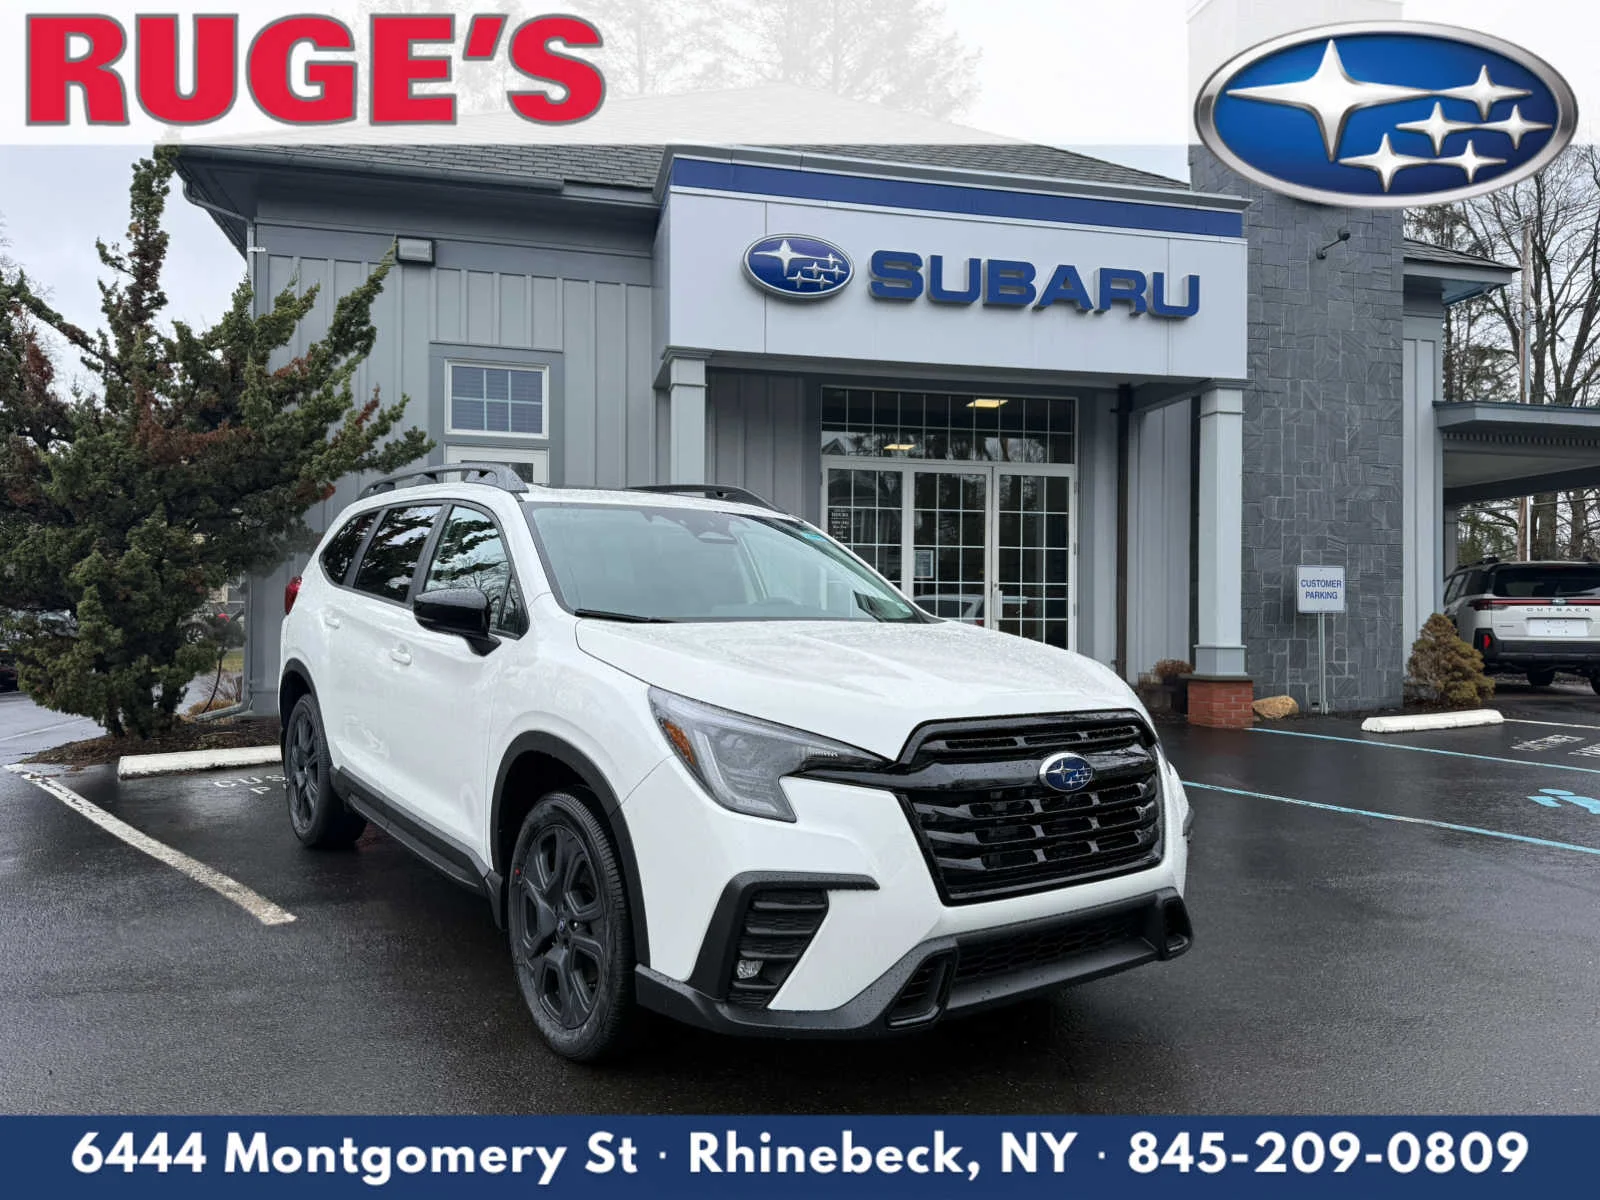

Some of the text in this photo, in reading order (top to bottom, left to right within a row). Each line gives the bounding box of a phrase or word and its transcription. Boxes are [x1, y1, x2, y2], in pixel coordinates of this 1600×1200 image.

[870, 249, 1201, 318] SUBARU
[1300, 579, 1342, 589] CUSTOMER
[1305, 591, 1338, 600] PARKING
